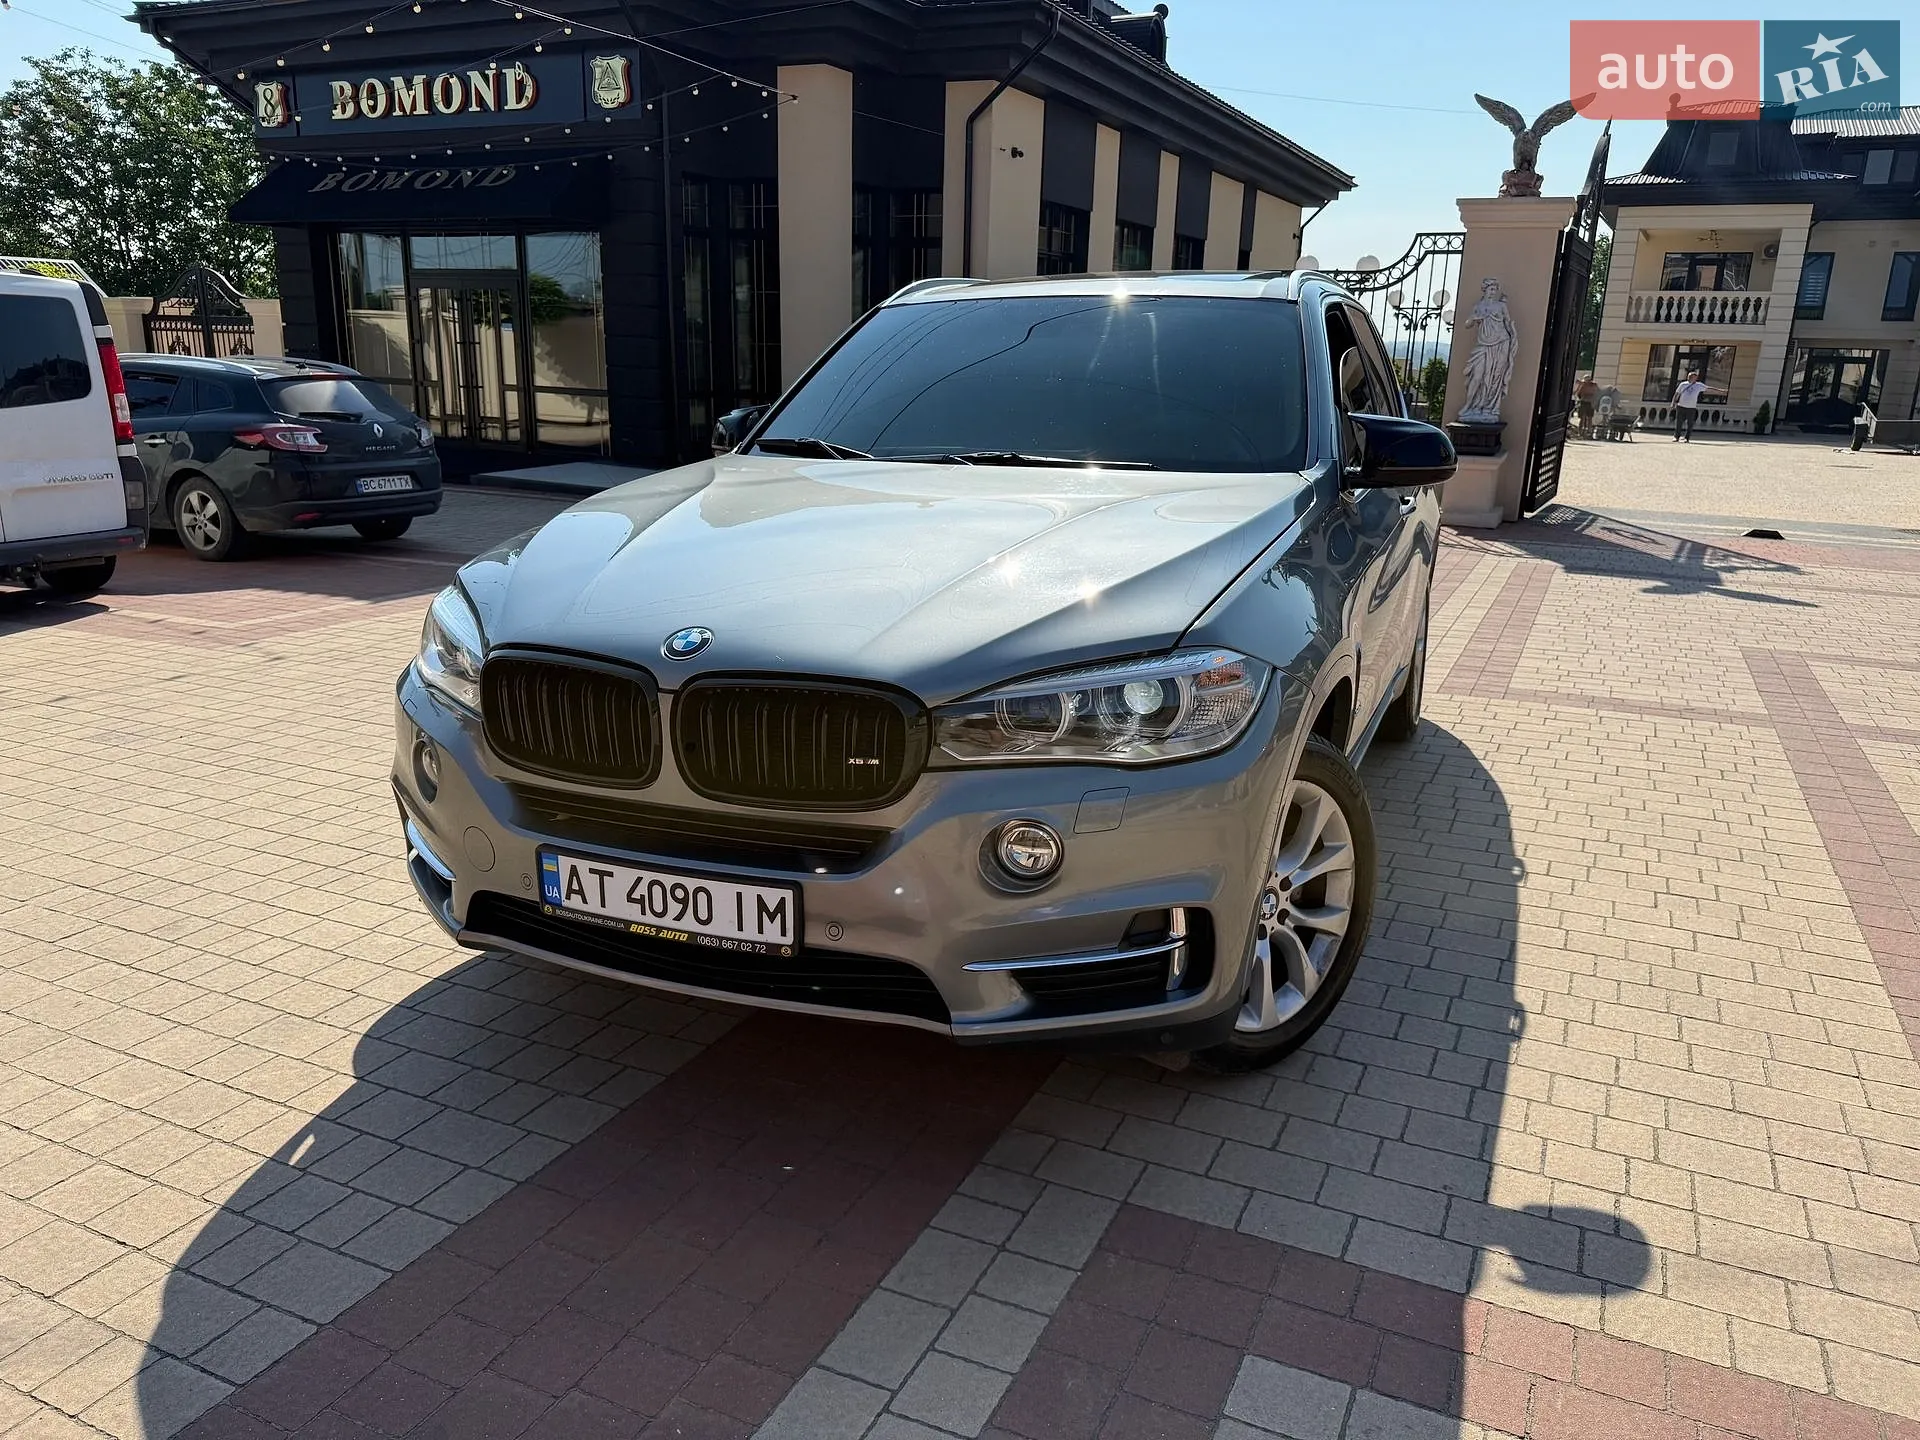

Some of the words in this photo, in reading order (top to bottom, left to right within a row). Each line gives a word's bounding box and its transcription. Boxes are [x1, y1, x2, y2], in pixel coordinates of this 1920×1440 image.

[329, 61, 537, 121] BOMOND
[307, 163, 517, 194] BOMOND
[377, 477, 397, 489] 6711
[545, 884, 560, 899] UA
[565, 864, 614, 909] AT
[626, 876, 713, 926] 4090
[736, 891, 787, 938] IM
[630, 923, 657, 936] BOSS
[660, 929, 689, 942] AUTO
[697, 936, 720, 947] (063)
[721, 939, 738, 950] 667
[740, 942, 752, 952] 02
[754, 944, 767, 954] 72
